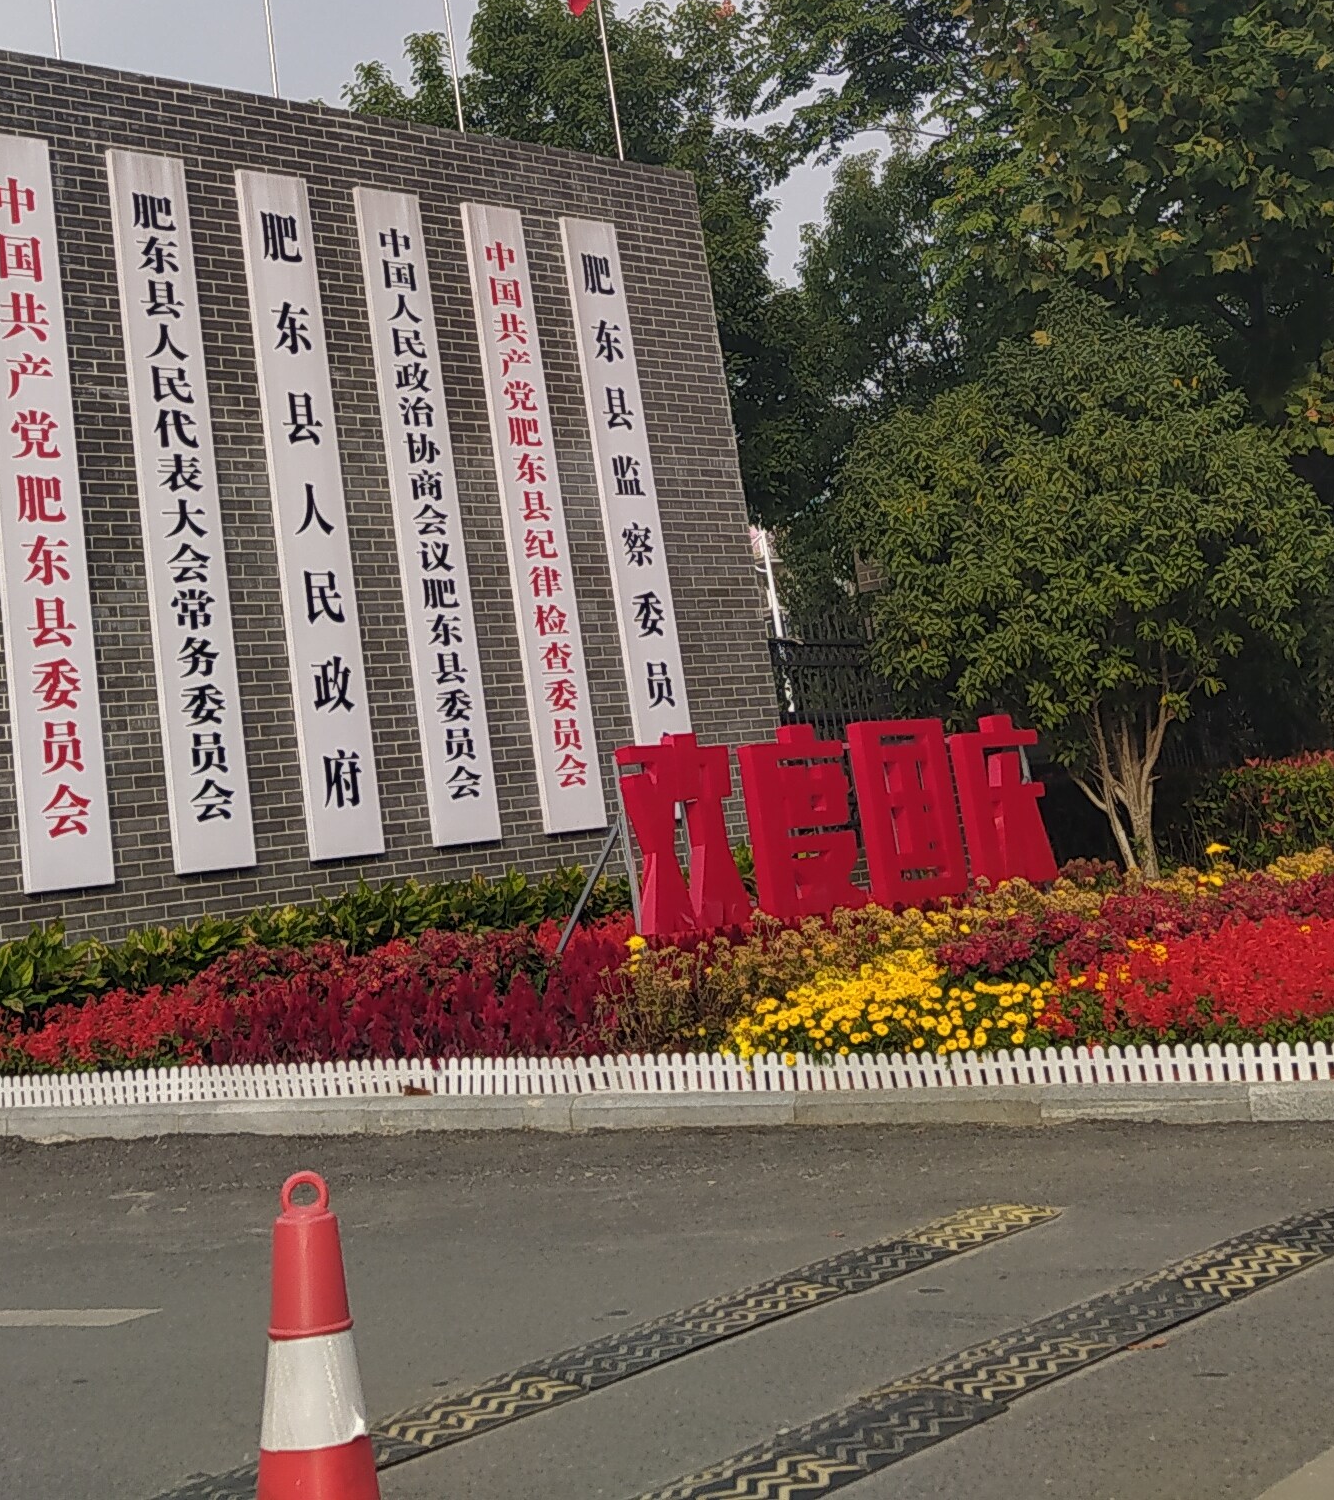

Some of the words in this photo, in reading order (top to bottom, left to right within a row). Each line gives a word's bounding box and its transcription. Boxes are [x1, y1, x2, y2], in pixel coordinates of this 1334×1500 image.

[131, 191, 235, 824] 肥东县人民代表大会常务委员会
[259, 210, 363, 809] 肥东县人民政府
[378, 227, 482, 801] 中国人民政治协商会议肥东县委员会
[484, 241, 588, 790] 中国共产党肥东县纪律检查委员会
[579, 252, 677, 736] 肥东县监察委员
[614, 714, 1059, 936] 欢度国庆
